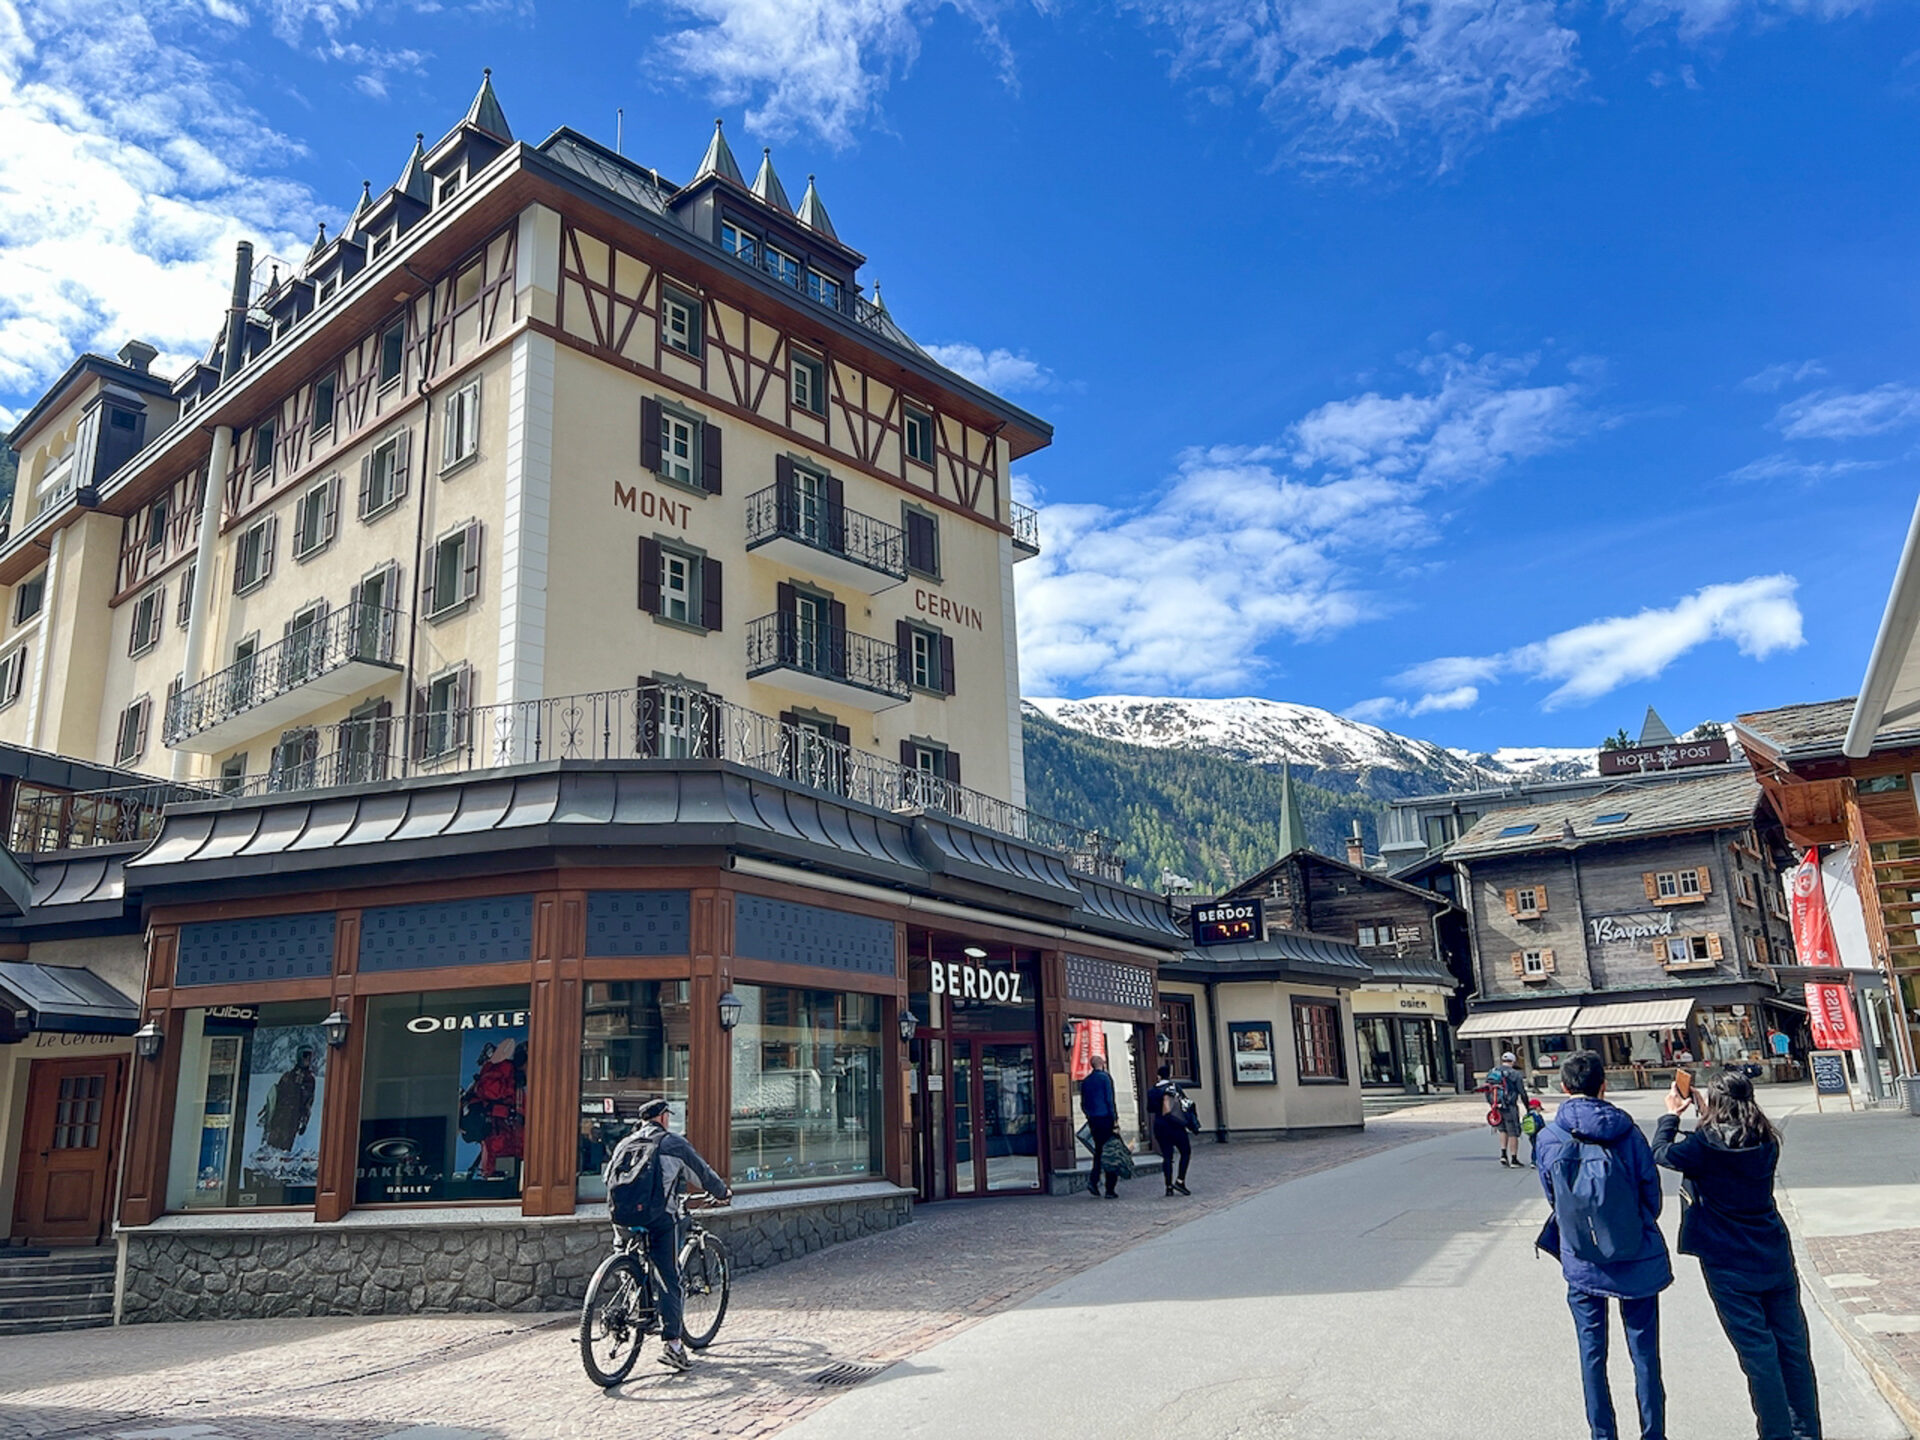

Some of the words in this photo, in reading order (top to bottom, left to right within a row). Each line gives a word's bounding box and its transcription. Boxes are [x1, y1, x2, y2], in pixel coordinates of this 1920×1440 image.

[614, 480, 692, 530] MONT
[915, 588, 983, 632] CERVIN
[1616, 753, 1657, 766] HOTEL
[1680, 746, 1711, 760] POST
[1198, 906, 1254, 921] BERDOZ
[1590, 912, 1673, 948] Bayard
[931, 960, 1022, 1003] BERDOZ
[443, 1011, 531, 1030] OAKLE
[35, 1032, 56, 1048] Le
[356, 1165, 428, 1179] OAKLEY
[386, 1186, 431, 1194] OAKLEY
